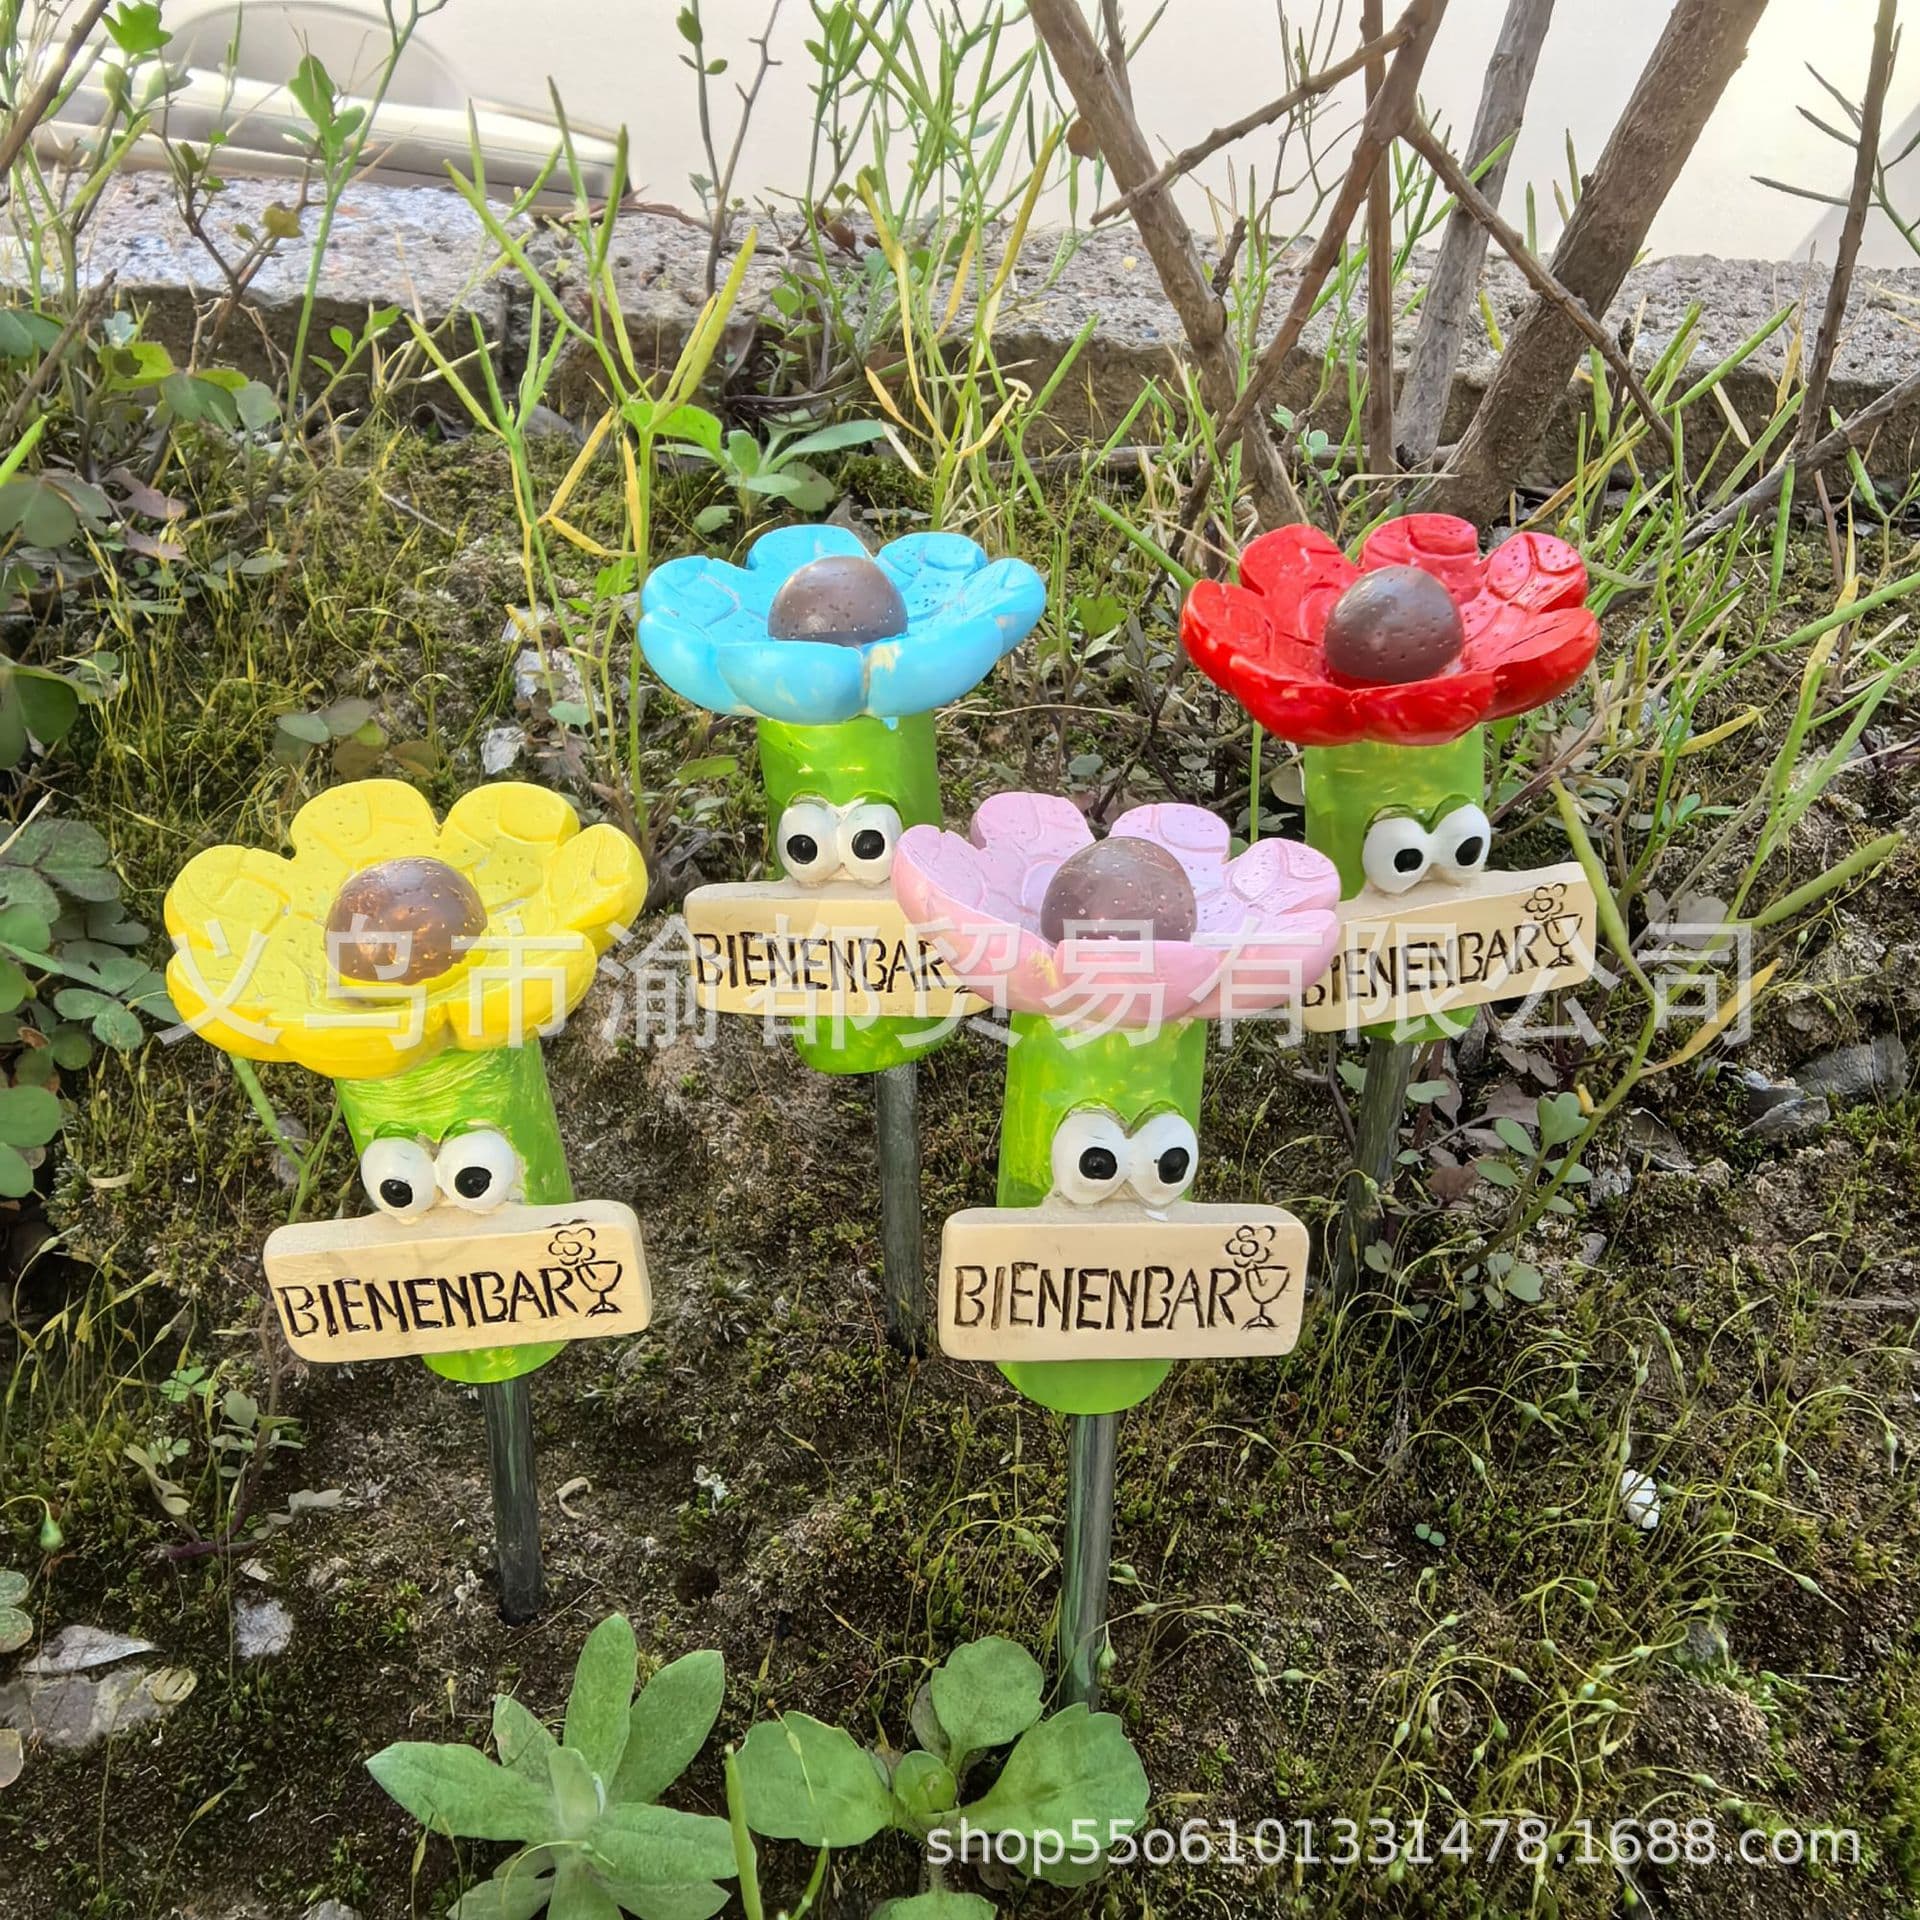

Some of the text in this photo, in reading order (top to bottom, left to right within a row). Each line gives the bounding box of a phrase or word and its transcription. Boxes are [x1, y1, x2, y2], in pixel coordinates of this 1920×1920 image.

[692, 931, 946, 993] BIENENBAR
[277, 1267, 579, 1338] BIENENBAR
[954, 1262, 1242, 1332] BIENENBAR
